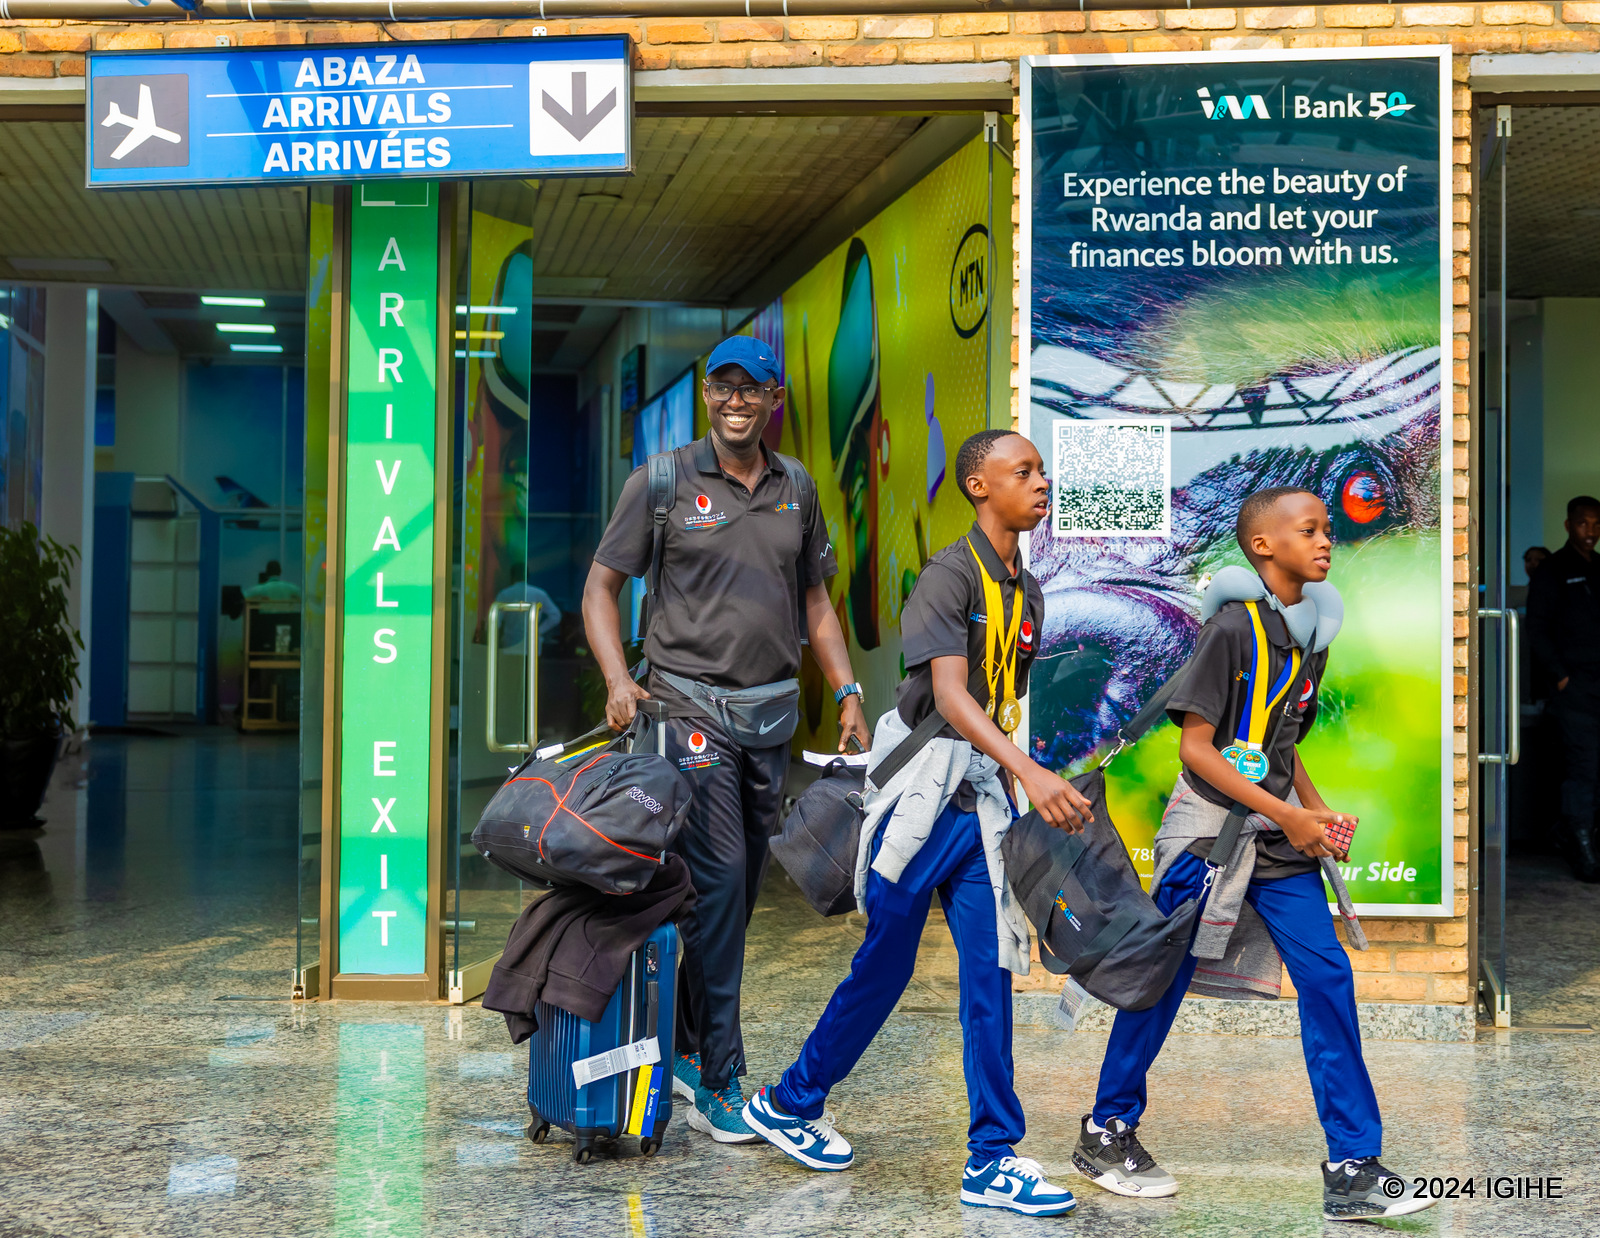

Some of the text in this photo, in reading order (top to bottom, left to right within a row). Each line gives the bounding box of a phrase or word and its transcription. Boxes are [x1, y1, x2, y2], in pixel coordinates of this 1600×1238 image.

[295, 54, 425, 88] ABAZA
[262, 91, 452, 127] ARRIVALS
[1294, 93, 1363, 119] Bank
[263, 130, 451, 173] ARRIVÉES
[1063, 165, 1408, 204] Experience the beauty of
[1092, 203, 1379, 237] Rwanda and let your
[1070, 239, 1399, 268] finances bloom with us.
[959, 256, 984, 307] MTN
[1053, 543, 1170, 553] SCAN TO GET STARTED
[370, 236, 406, 947] ARRIVALS EXIT
[625, 786, 664, 815] KWON
[1366, 861, 1417, 882] Side
